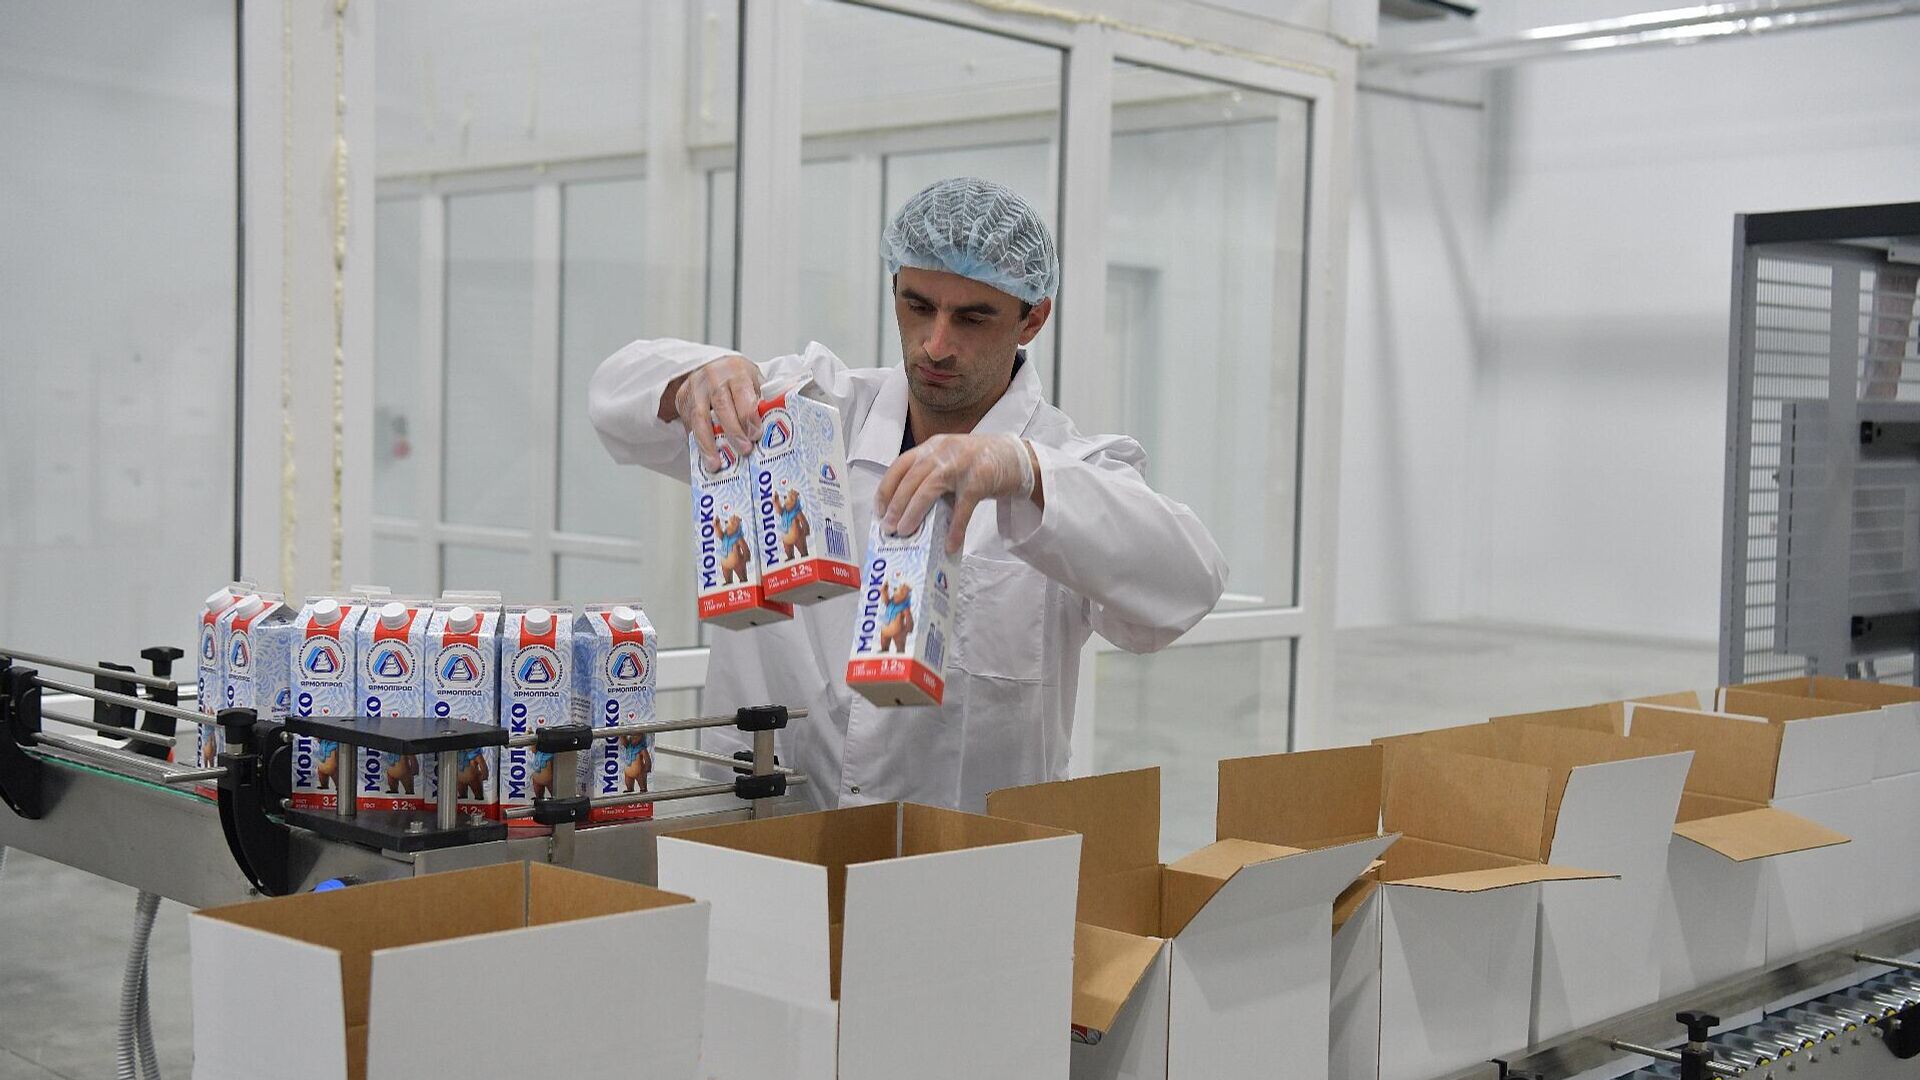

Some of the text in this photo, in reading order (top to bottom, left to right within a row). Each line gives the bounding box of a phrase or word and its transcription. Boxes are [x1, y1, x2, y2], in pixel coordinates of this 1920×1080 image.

[700, 494, 717, 591] МОЛОКО
[758, 470, 780, 568] МОЛОКО
[857, 559, 887, 654] МОЛОКО
[297, 692, 313, 787] МОЛКО
[508, 703, 527, 799] МОЛКО
[322, 796, 337, 806] 3.2
